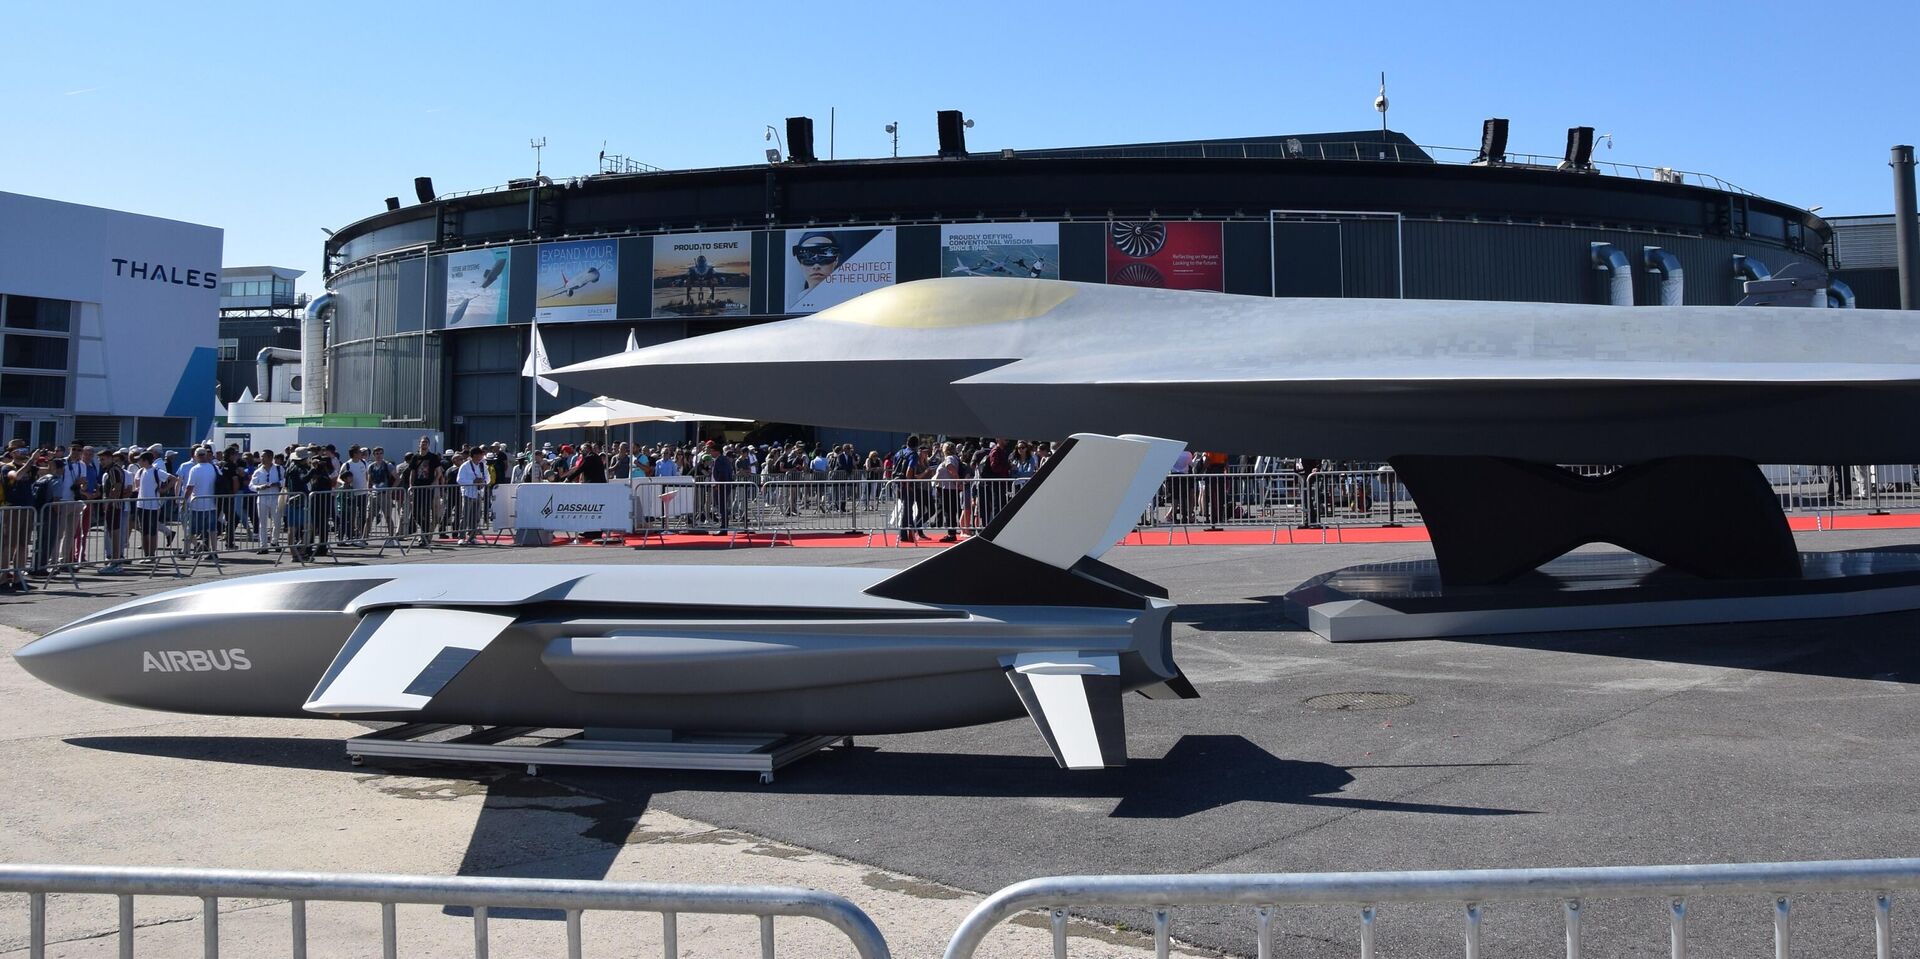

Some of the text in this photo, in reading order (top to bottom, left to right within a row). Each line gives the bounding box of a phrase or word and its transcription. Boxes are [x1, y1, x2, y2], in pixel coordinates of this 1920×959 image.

[541, 245, 613, 262] EXPAND YOUR
[541, 259, 614, 273] EXPECTATIONS
[838, 262, 892, 272] ARCHITECT
[112, 258, 216, 289] THALES
[825, 273, 892, 283] OF THE FUTURE
[557, 504, 606, 512] DASSAULT
[143, 648, 252, 672] AIRBUS
